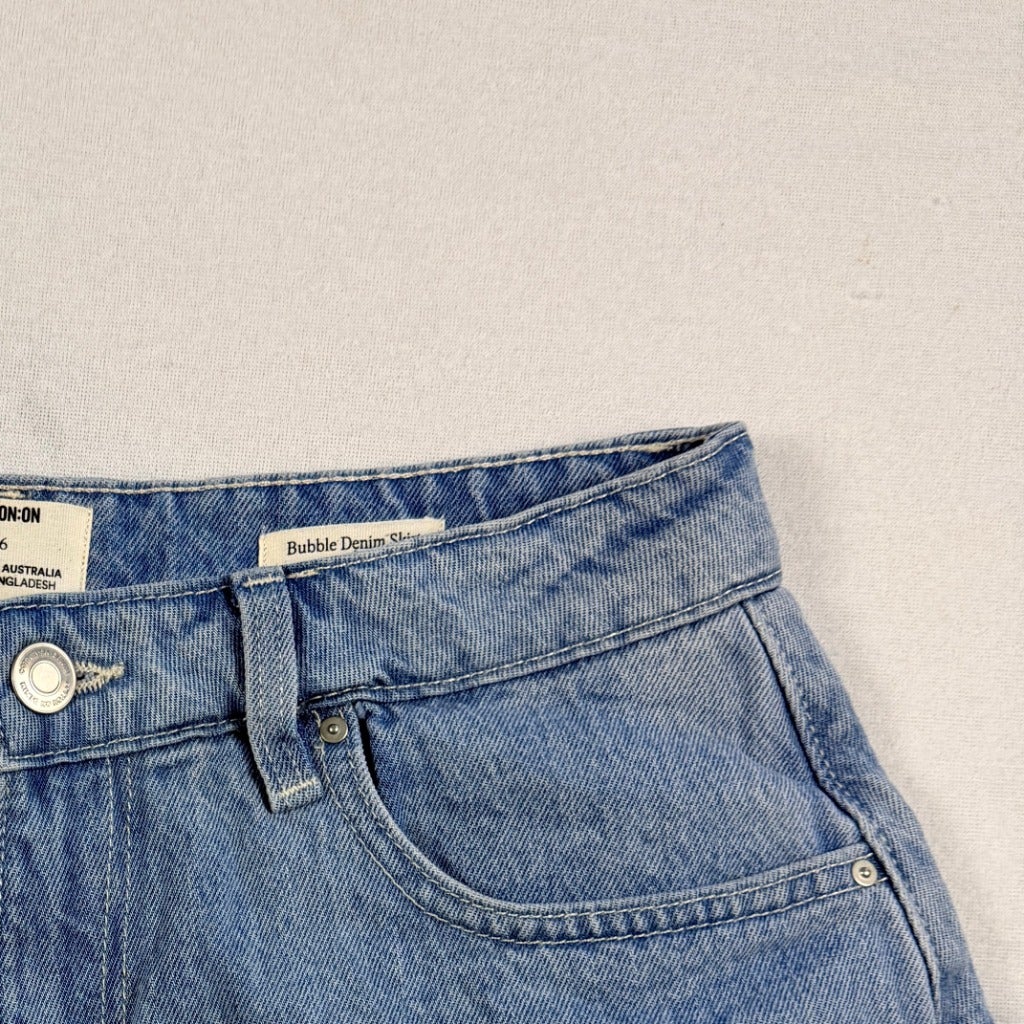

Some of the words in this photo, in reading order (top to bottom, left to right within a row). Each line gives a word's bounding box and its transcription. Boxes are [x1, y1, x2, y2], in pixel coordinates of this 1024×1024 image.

[287, 538, 337, 556] Bubble
[341, 535, 385, 550] Denim
[2, 565, 62, 578] AUSTRALIA
